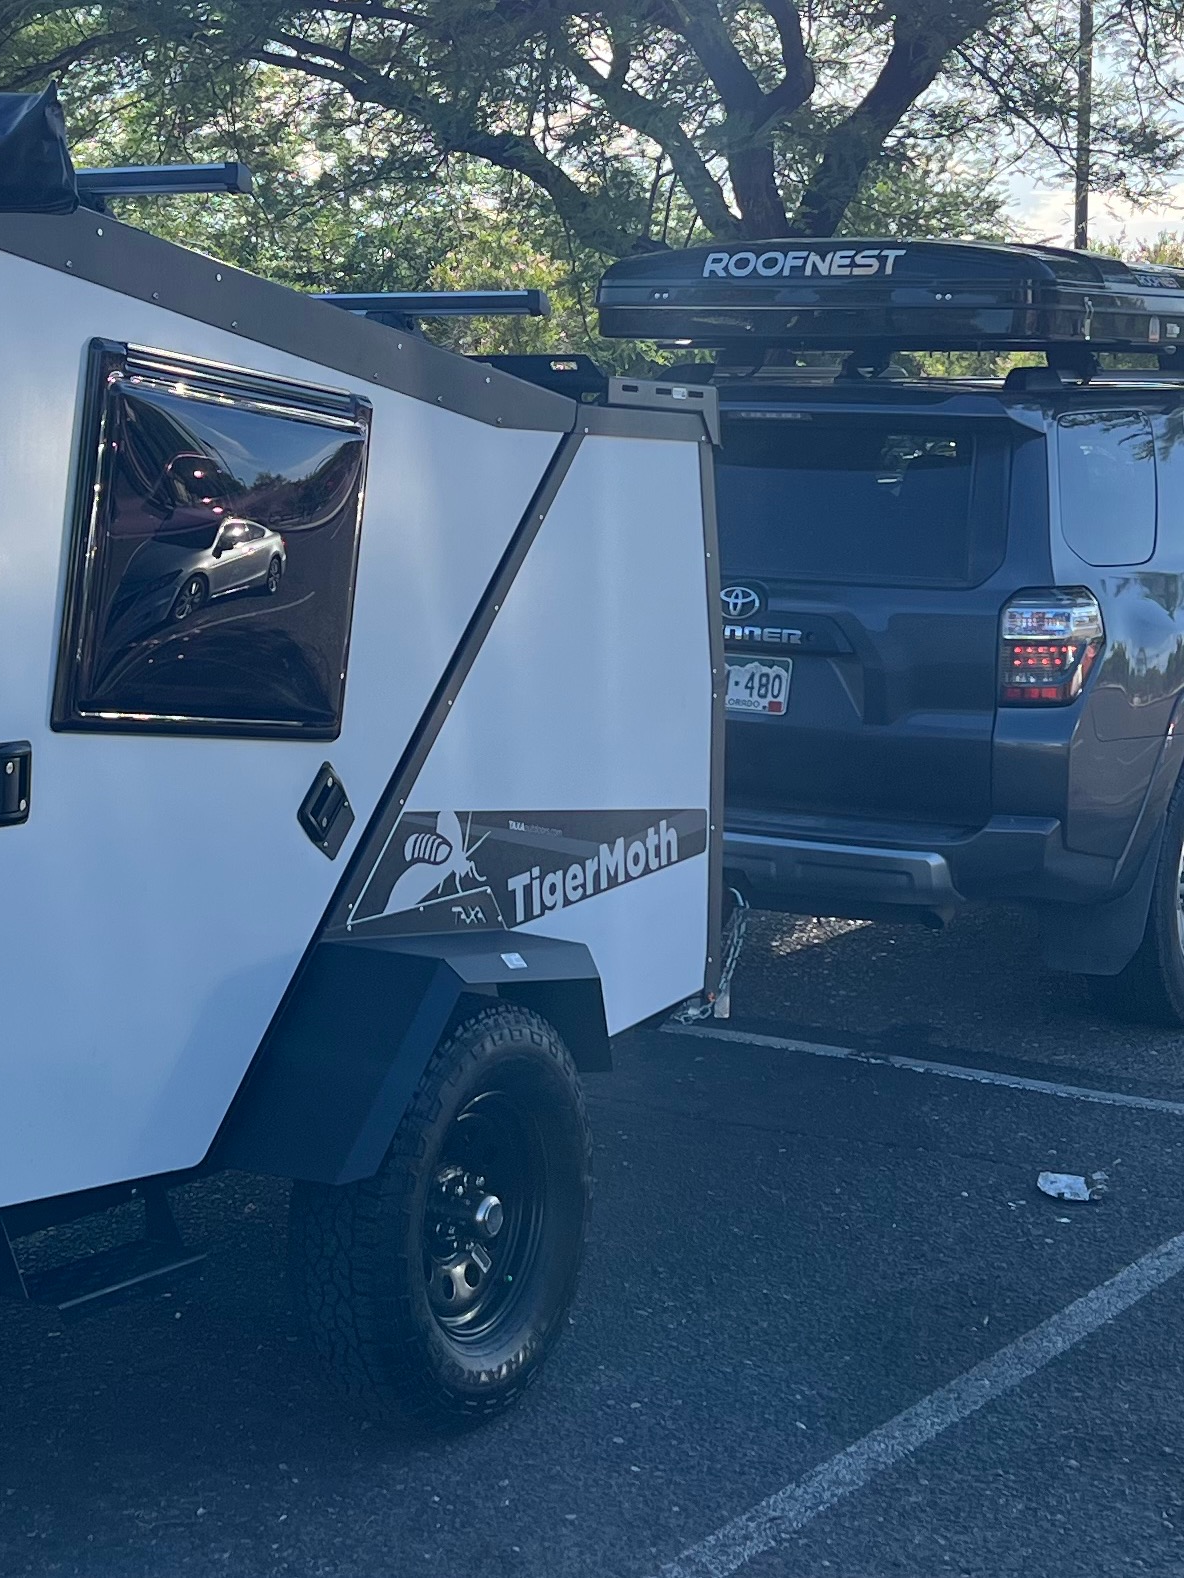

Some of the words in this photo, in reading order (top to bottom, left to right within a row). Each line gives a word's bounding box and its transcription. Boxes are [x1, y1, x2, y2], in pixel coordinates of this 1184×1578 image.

[702, 249, 907, 278] ROOFNEST
[722, 624, 802, 645] NNER
[508, 819, 678, 924] TigerMoth
[451, 905, 487, 925] TAXA
